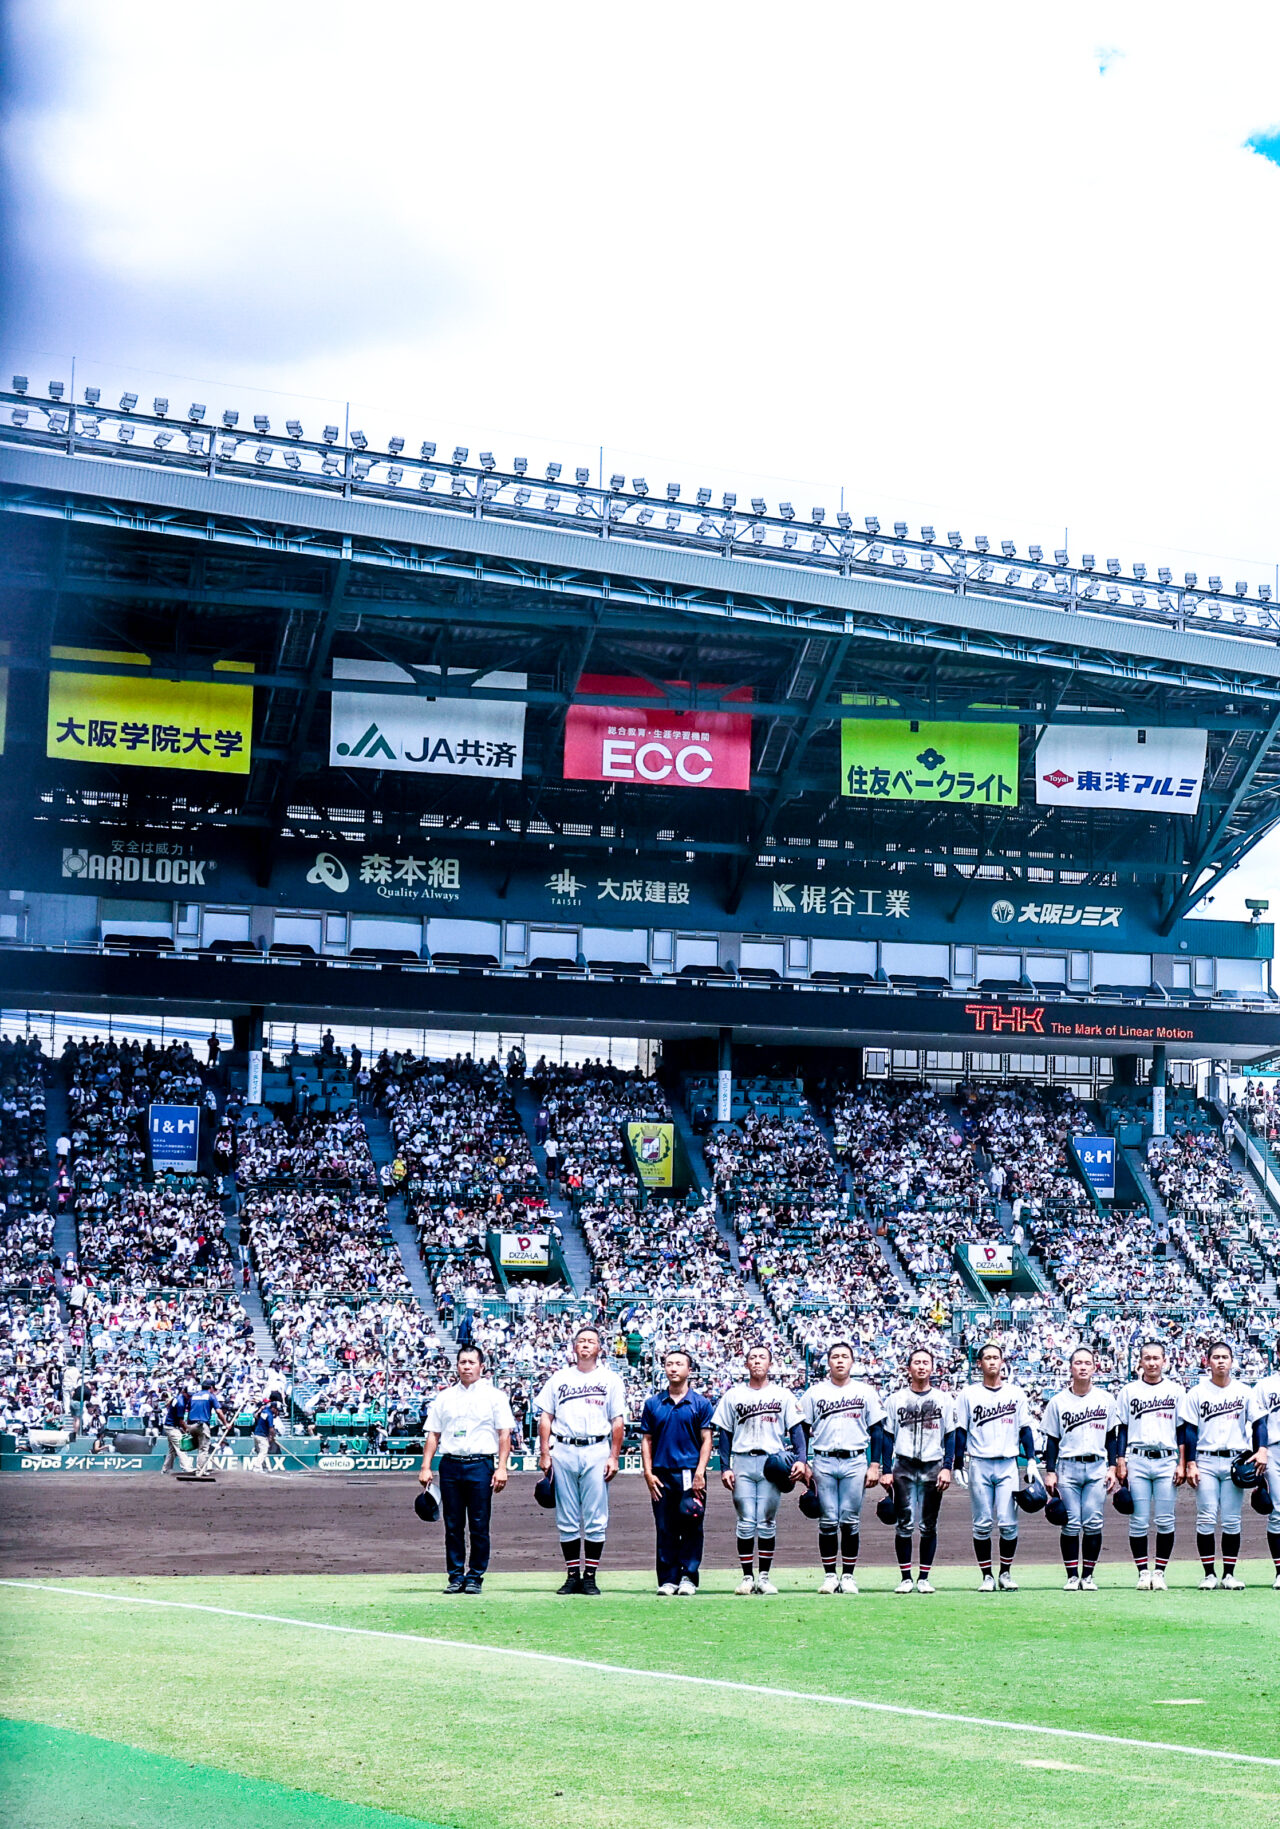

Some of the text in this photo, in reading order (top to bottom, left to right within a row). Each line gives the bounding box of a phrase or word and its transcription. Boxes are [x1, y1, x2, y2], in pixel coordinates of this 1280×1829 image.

[56, 717, 243, 758] 大阪学院大学
[405, 737, 517, 768] JA共済
[602, 739, 713, 783] ECC
[847, 765, 1012, 802] 住友ベークライト
[1076, 771, 1198, 798] 東洋アルミ
[359, 853, 461, 889] 森本組
[377, 886, 460, 902] Quality Always
[552, 898, 581, 906] TAISEI
[597, 878, 690, 905] 大成建設
[800, 885, 911, 918] 梶谷工業
[1018, 903, 1123, 927] 大阪シミズ
[965, 1004, 1045, 1033] THK
[1051, 1023, 1194, 1039] The Mark of Linear Motion
[817, 1394, 864, 1415] Risshodai
[1061, 1405, 1107, 1428] Risshodai
[1130, 1395, 1176, 1415] Risshodai
[21, 1456, 143, 1471] DyDo ダイドードリンコ
[356, 1457, 415, 1470] ウエルシア
